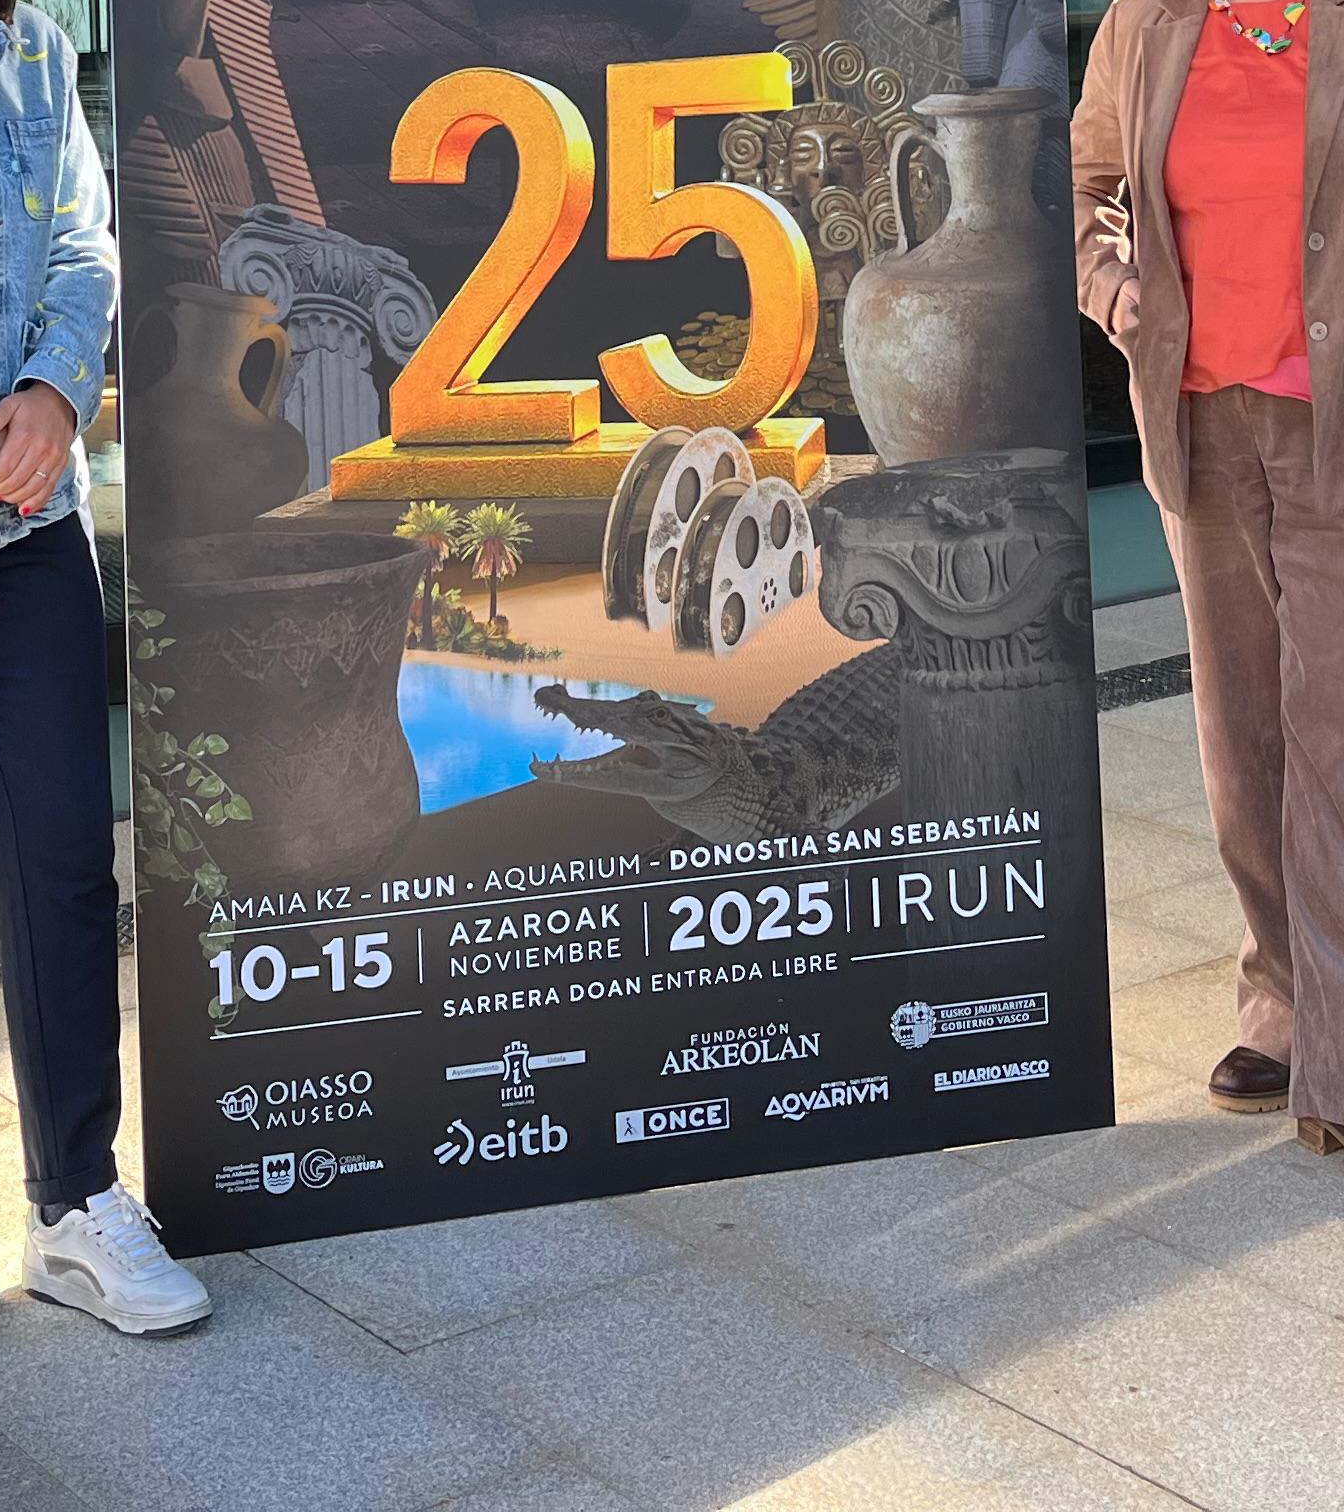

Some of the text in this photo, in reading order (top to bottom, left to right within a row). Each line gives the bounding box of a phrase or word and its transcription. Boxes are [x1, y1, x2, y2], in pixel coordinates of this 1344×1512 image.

[389, 51, 819, 448] 25
[208, 891, 307, 924] AMAIA
[317, 887, 352, 911] KZ
[382, 875, 456, 904] IRUN
[484, 854, 641, 893] AQUARIUM
[670, 834, 819, 872] DONOSTIA
[827, 827, 882, 854] SAN
[890, 807, 1041, 846] SEBASTIÁN
[871, 859, 1046, 928] IRUN
[449, 903, 621, 947] AZAROAK
[668, 880, 834, 952] 2025
[208, 931, 393, 1007] 10-15
[450, 937, 623, 978] NOVIEMBRE
[443, 953, 839, 1019] SARRERA DOAN ENTRADA LIBRE
[940, 999, 1036, 1019] EUSKO JAURLARITZA
[941, 1013, 1030, 1032] GOBIERNO VASCO
[660, 1033, 821, 1076] ARKEOLAN
[690, 1022, 790, 1046] FUNDACIÓN
[265, 1070, 373, 1105] OIASSO
[501, 1084, 534, 1101] irun
[934, 1059, 1050, 1087] EL DIARIO VASCO
[265, 1100, 374, 1130] MUSEOA
[648, 1104, 723, 1133] ONCE
[478, 1114, 568, 1162] eitb
[340, 1160, 384, 1174] KULTURA
